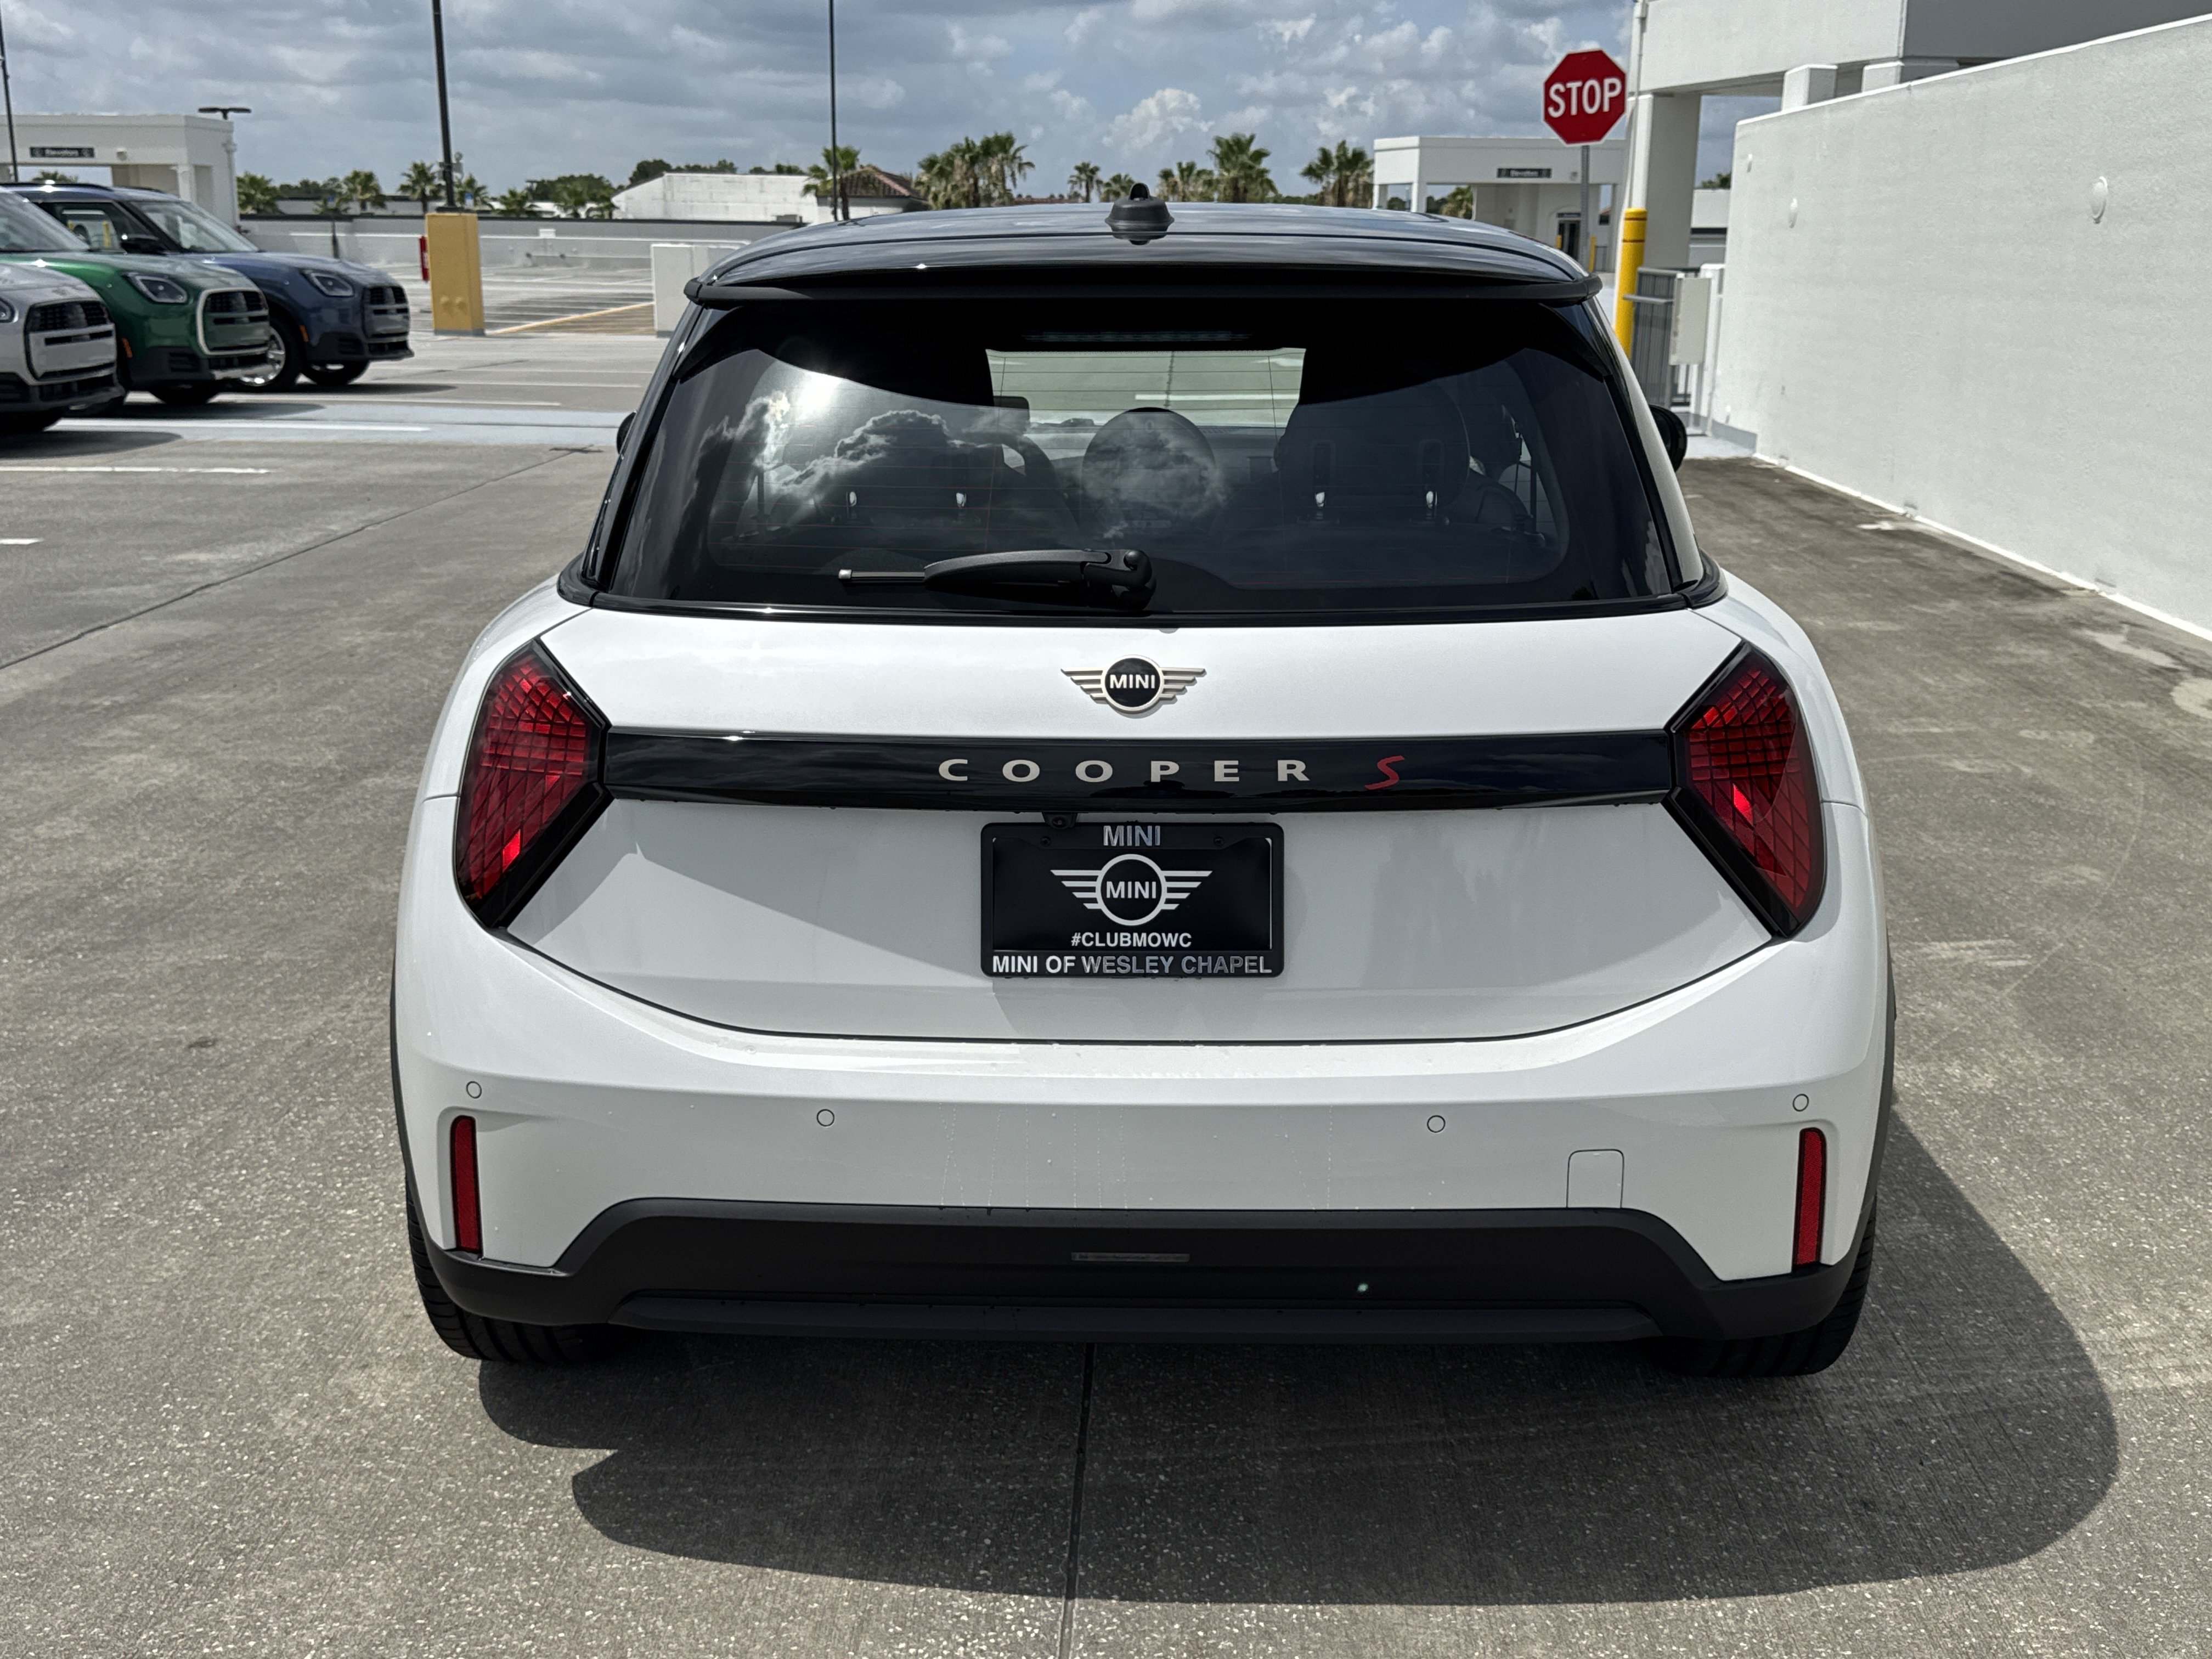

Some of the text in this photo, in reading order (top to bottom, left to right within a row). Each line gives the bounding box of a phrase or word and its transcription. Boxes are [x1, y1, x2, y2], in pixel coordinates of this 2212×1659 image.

[1548, 77, 1622, 117] STOP
[1109, 674, 1156, 689] MINI
[938, 755, 1406, 791] COOPER S
[1103, 825, 1161, 847] MINI
[1106, 881, 1156, 899] MINI
[1071, 932, 1192, 948] #CLUBMOWC
[992, 956, 1272, 973] MINI OF WESLEY CHAPEL
